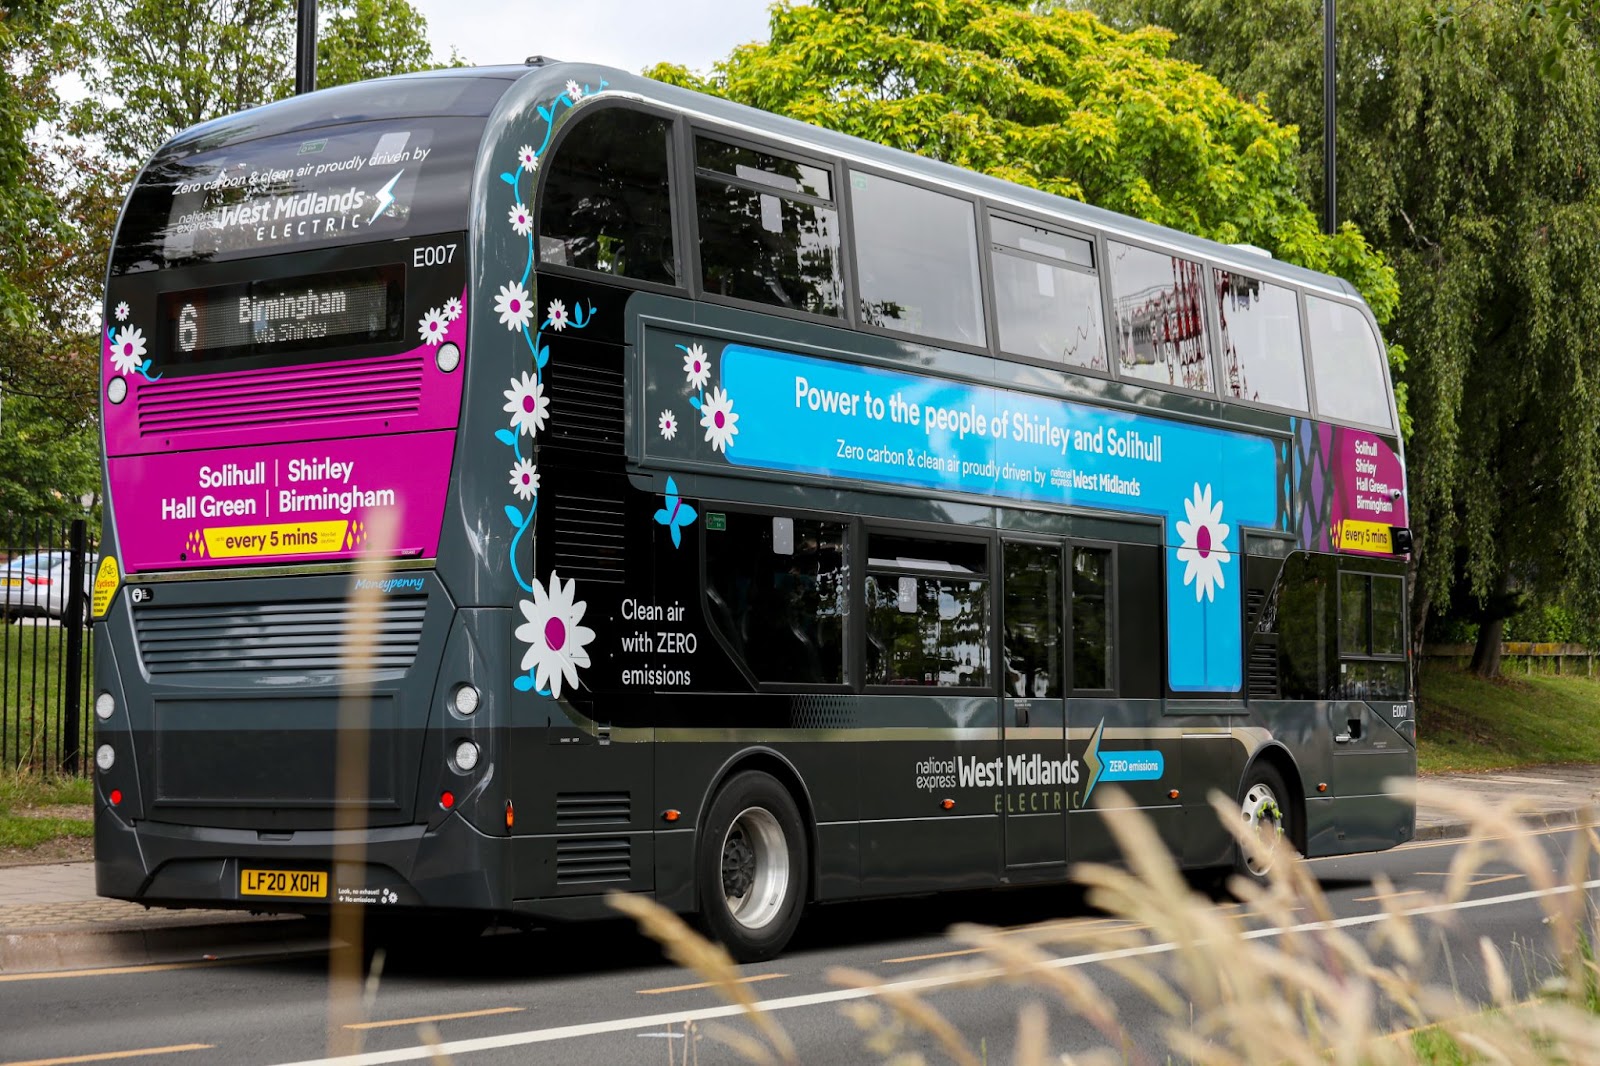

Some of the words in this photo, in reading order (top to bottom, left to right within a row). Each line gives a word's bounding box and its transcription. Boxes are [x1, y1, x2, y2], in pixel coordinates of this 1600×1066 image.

[172, 182, 201, 195] Zero
[203, 176, 246, 190] carbon
[248, 171, 259, 183] &
[260, 169, 294, 182] clean
[296, 162, 314, 177] air
[315, 156, 367, 177] proudly
[369, 151, 410, 166] driven
[413, 147, 431, 161] by
[179, 208, 220, 224] national
[220, 201, 271, 228] West
[274, 187, 365, 219] Midlands
[257, 214, 361, 241] ELECTRIC
[413, 244, 457, 268] E007
[179, 303, 198, 352] 6
[239, 289, 346, 323] Birmingham
[279, 321, 327, 341] Shirley
[795, 376, 860, 416] Power
[864, 390, 885, 421] to
[889, 392, 921, 426] the
[925, 404, 987, 440] people
[991, 409, 1009, 439] of
[1012, 412, 1070, 455] Shirley
[1074, 426, 1103, 454] and
[1107, 428, 1162, 463] Solihull
[1355, 439, 1378, 457] Solihull
[288, 456, 354, 484] Shirley
[836, 439, 864, 460] Zero
[866, 445, 905, 466] carbon
[907, 448, 915, 467] &
[917, 451, 945, 471] clean
[947, 455, 959, 473] air
[962, 459, 1000, 482] proudly
[1002, 462, 1032, 483] driven
[1034, 465, 1046, 488] by
[1050, 468, 1072, 478] national
[1355, 458, 1377, 477] Shirley
[199, 462, 265, 489] Solihull
[1050, 478, 1072, 488] express
[1073, 469, 1098, 491] West
[1100, 473, 1141, 497] Midlands
[1356, 476, 1368, 491] Hall
[1369, 478, 1388, 494] Green
[161, 496, 196, 520] Hall
[200, 495, 256, 518] Green
[279, 485, 395, 515] Birmingham
[1356, 495, 1393, 515] Birmingham
[225, 535, 267, 551] every
[270, 530, 279, 547] 5
[282, 528, 318, 546] mins
[1345, 528, 1365, 546] every
[1366, 528, 1371, 543] 5
[1372, 527, 1388, 544] mins
[96, 580, 116, 589] Cyclists
[354, 578, 425, 593] Moneypenny
[621, 598, 663, 621] Clean
[667, 600, 685, 622] air
[621, 631, 653, 653] with
[657, 632, 698, 654] ZERO
[621, 663, 691, 685] emissions
[1392, 704, 1408, 718] E007
[916, 756, 956, 775] national
[957, 755, 1004, 788] West
[1007, 753, 1080, 787] Midlands
[1109, 760, 1128, 773] ZERO
[1128, 760, 1159, 773] emissions
[916, 772, 956, 793] express
[994, 790, 1081, 813] ELECTRIC
[248, 872, 286, 891] LF20
[290, 873, 320, 892] XOH
